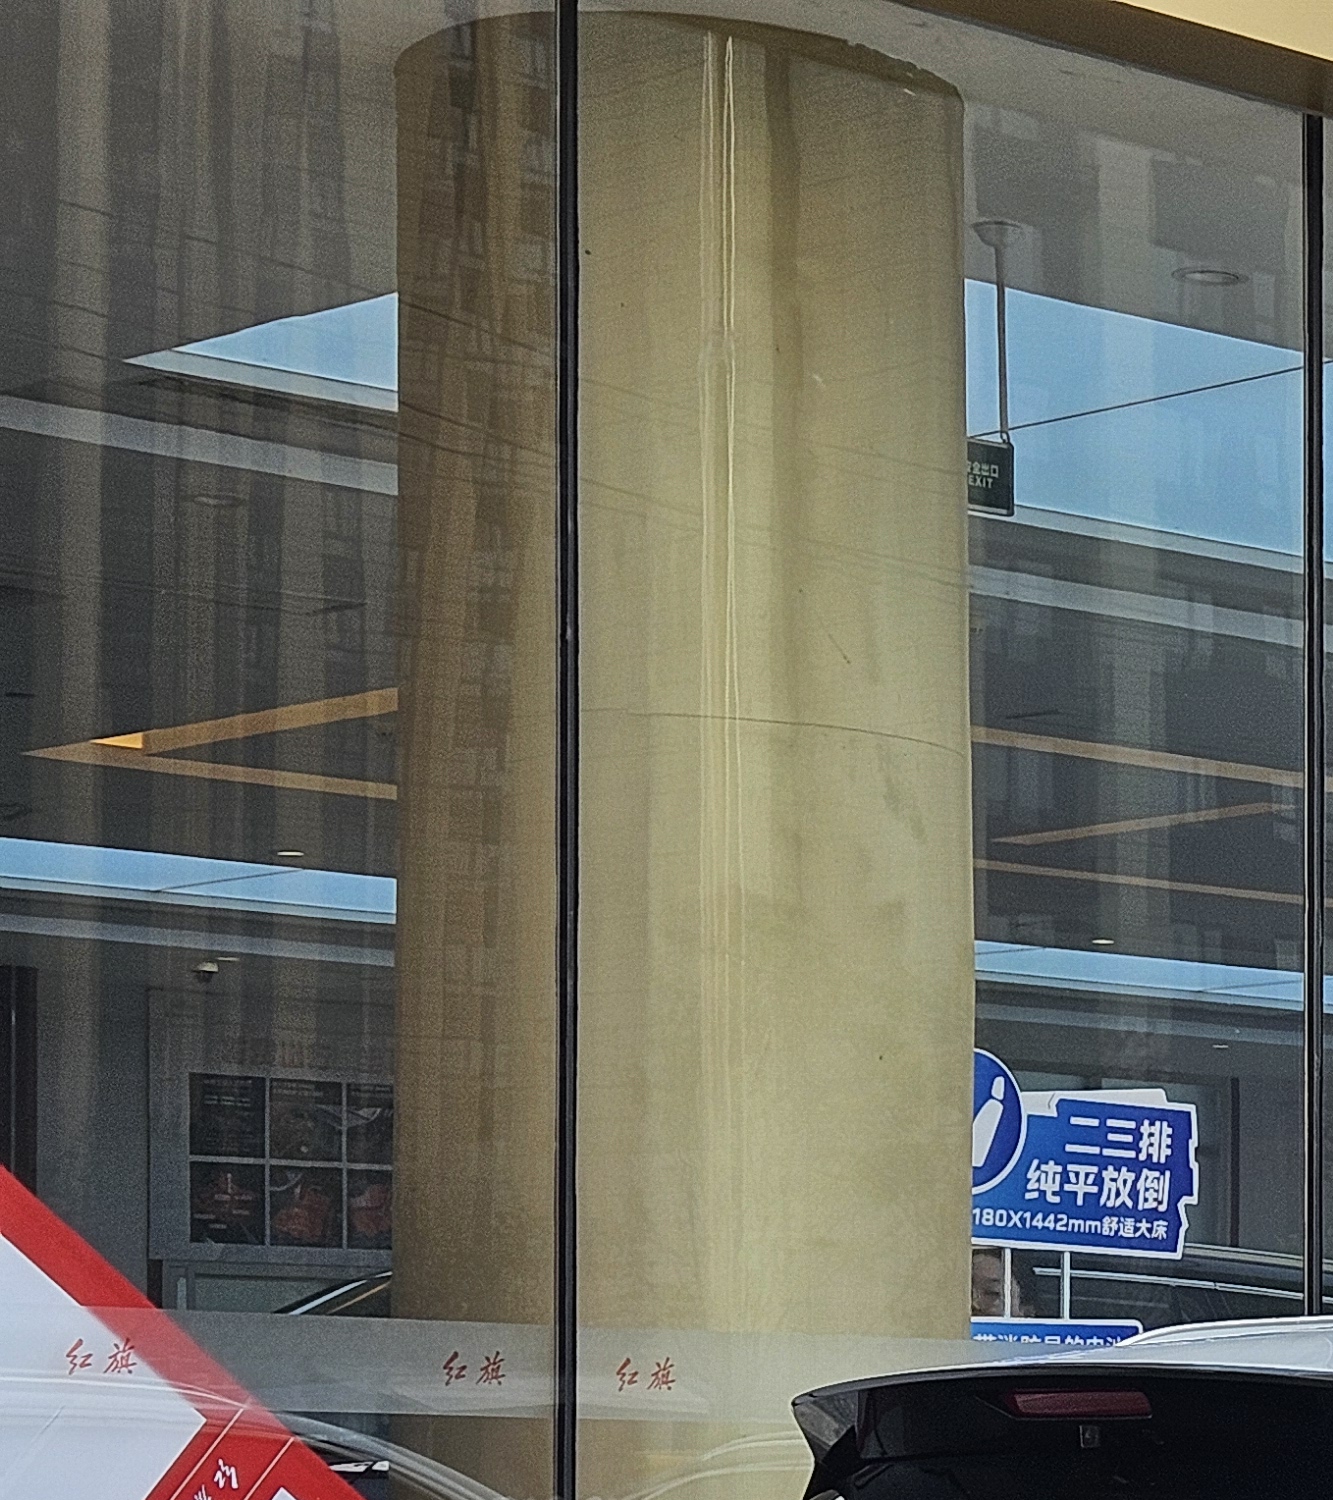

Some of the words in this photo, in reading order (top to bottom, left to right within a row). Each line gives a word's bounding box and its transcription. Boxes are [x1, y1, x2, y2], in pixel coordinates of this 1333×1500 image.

[968, 474, 993, 489] EXIT
[1065, 1115, 1173, 1164] 二三排
[1024, 1158, 1171, 1212] 纯平放倒
[66, 1337, 138, 1376] 红旗
[443, 1350, 507, 1387] 红旗
[615, 1356, 677, 1392] 红旗
